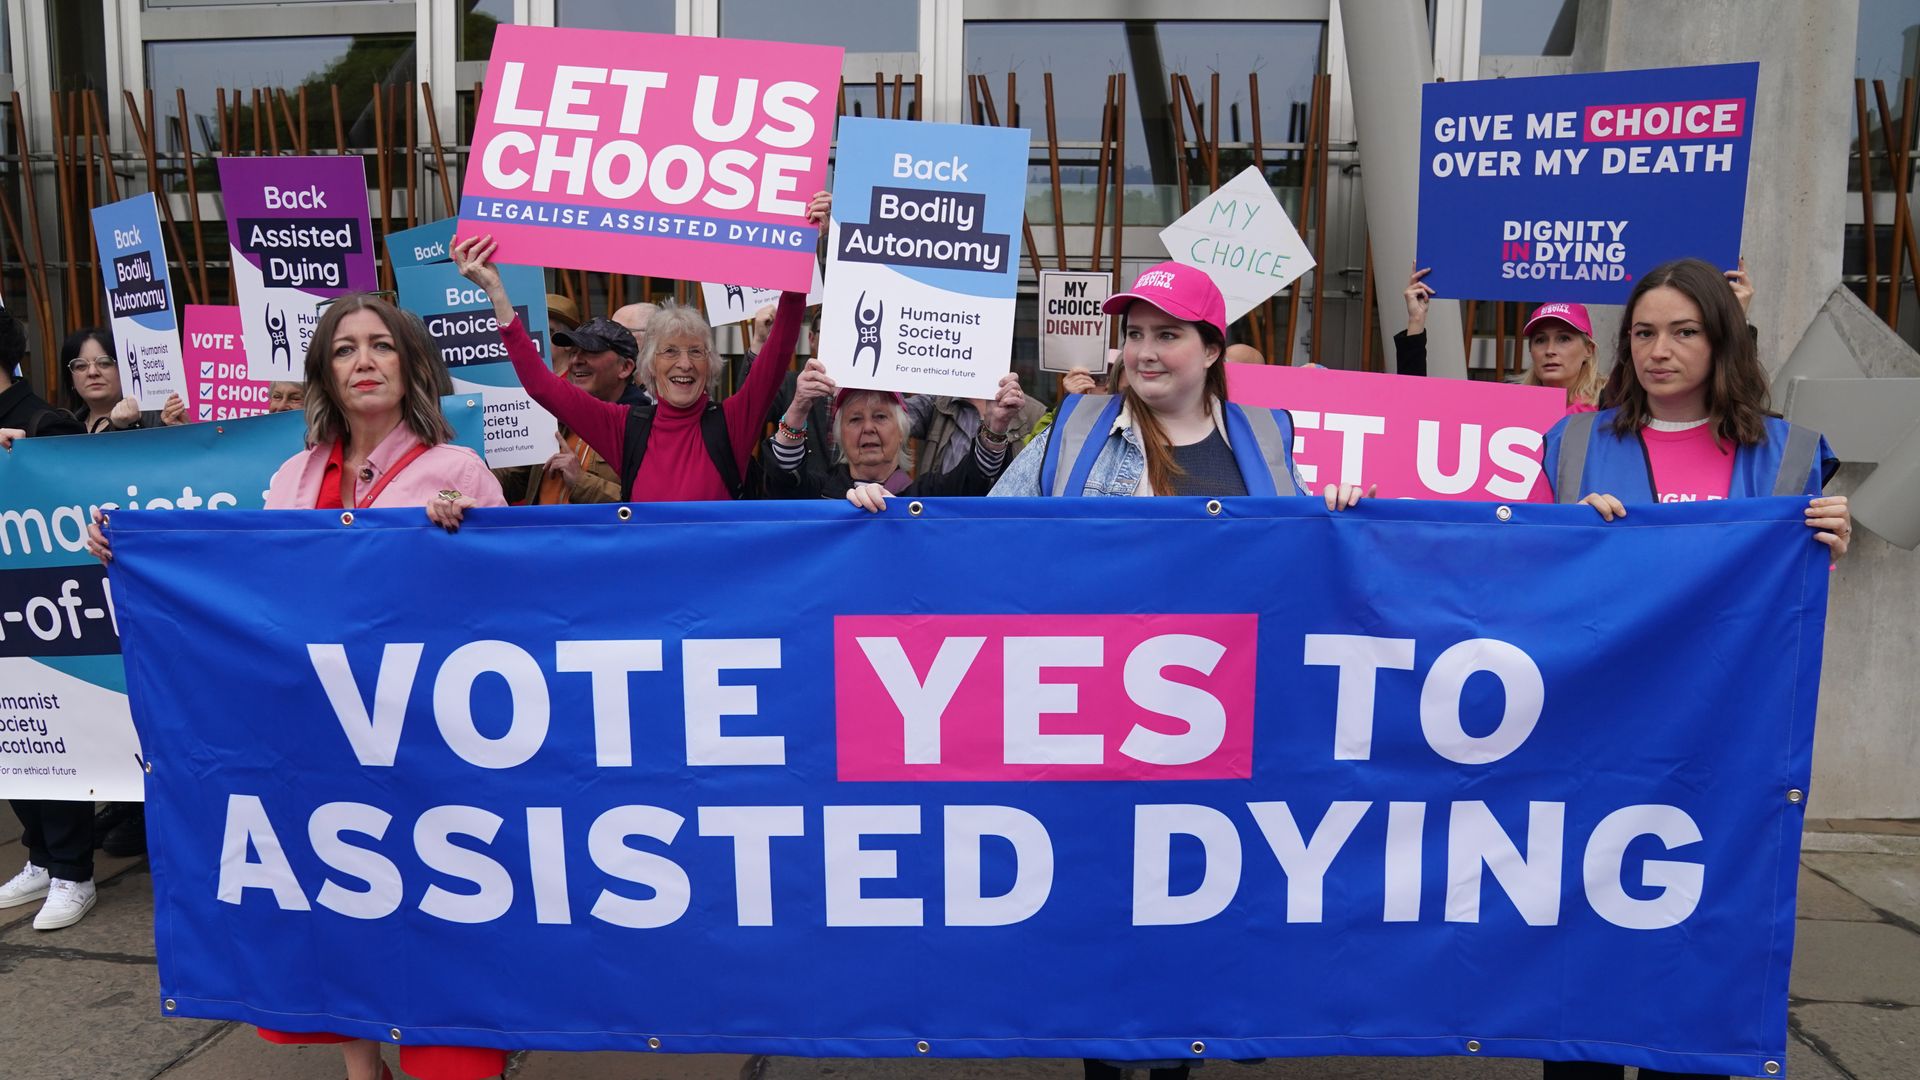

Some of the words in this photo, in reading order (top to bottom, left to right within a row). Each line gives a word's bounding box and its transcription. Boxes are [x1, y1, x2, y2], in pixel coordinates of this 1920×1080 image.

[493, 61, 668, 135] LET
[692, 74, 820, 149] US
[1434, 114, 1513, 143] GIVE
[1526, 111, 1577, 139] ME
[1589, 103, 1738, 138] CHOICE
[893, 152, 969, 183] Back
[1432, 150, 1521, 178] OVER
[1534, 148, 1589, 176] MY
[1601, 143, 1733, 175] DEATH
[481, 130, 812, 217] CHOOSE
[263, 184, 327, 209] Back
[879, 193, 975, 232] Bodily
[1208, 199, 1261, 231] MY
[250, 223, 352, 248] Assisted
[476, 201, 590, 226] LEGALISE
[599, 211, 718, 238] ASSISTED
[728, 224, 804, 248] DYING
[1503, 220, 1628, 242] DIGNITY
[114, 224, 142, 249] Back
[414, 241, 445, 261] Back
[845, 228, 1001, 270] Autonomy
[1190, 238, 1292, 279] CHOICE
[1503, 242, 1530, 262] IN
[1535, 242, 1626, 263] DYING
[117, 259, 152, 283] Bodily
[269, 257, 340, 287] Dying
[1501, 262, 1633, 282] SCOTLAND.
[114, 287, 166, 312] Autonomy
[446, 287, 492, 306] Bac
[1064, 281, 1088, 298] MY
[900, 306, 981, 326] Humanist
[1048, 299, 1104, 317] CHOICE,
[428, 315, 499, 338] Choice
[898, 323, 961, 345] Society
[1046, 319, 1103, 336] DIGNITY
[191, 333, 234, 350] VOTE
[897, 341, 972, 360] Scotland
[144, 369, 171, 383] Scotland
[218, 363, 246, 379] DIG
[895, 364, 909, 372] For
[923, 367, 950, 376] ethical
[951, 369, 976, 378] future
[217, 384, 269, 402] CHOIC
[494, 445, 514, 454] ethical
[1416, 420, 1544, 500] US
[0, 692, 60, 709] manist
[306, 638, 786, 770] VOTE
[855, 633, 1228, 766] YES
[1303, 633, 1546, 765] TO
[0, 736, 66, 754] cotland
[12, 767, 22, 775] an
[24, 766, 51, 775] ethical
[52, 765, 77, 775] future
[216, 794, 1055, 929] ASSISTED
[1131, 799, 1706, 930] DYING
